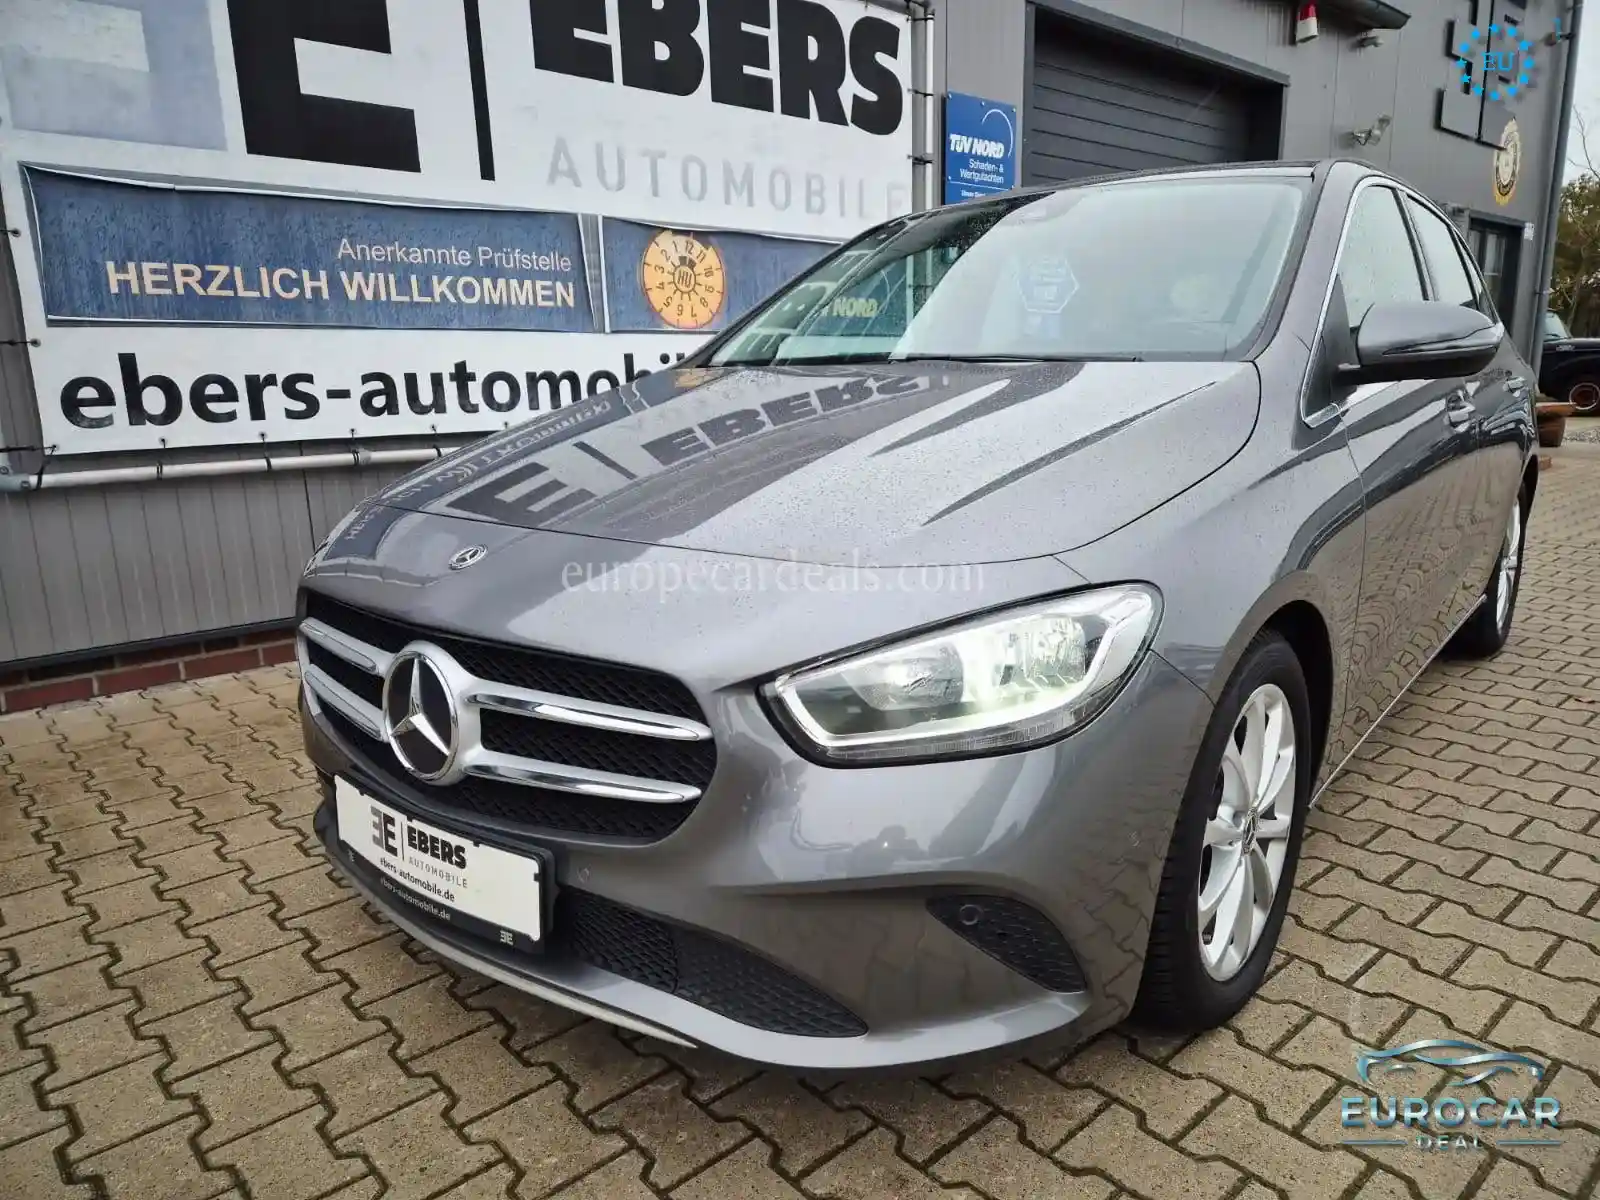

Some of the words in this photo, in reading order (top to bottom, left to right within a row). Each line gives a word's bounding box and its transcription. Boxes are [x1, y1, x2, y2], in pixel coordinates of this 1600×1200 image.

[530, 0, 903, 136] EBERS
[971, 139, 1005, 159] NORD
[547, 136, 909, 220] AUTOMOBILE
[338, 238, 472, 266] Anerkannte
[478, 246, 572, 272] Prüfstelle
[105, 260, 330, 300] HERZLICH
[339, 270, 575, 308] WILLKOMMEN
[832, 297, 877, 318] NORD
[59, 351, 686, 431] ebers-automo
[407, 824, 467, 869] EBERS
[380, 856, 455, 902] ebers-automobile.de
[408, 856, 468, 889] AUTOMOBILE
